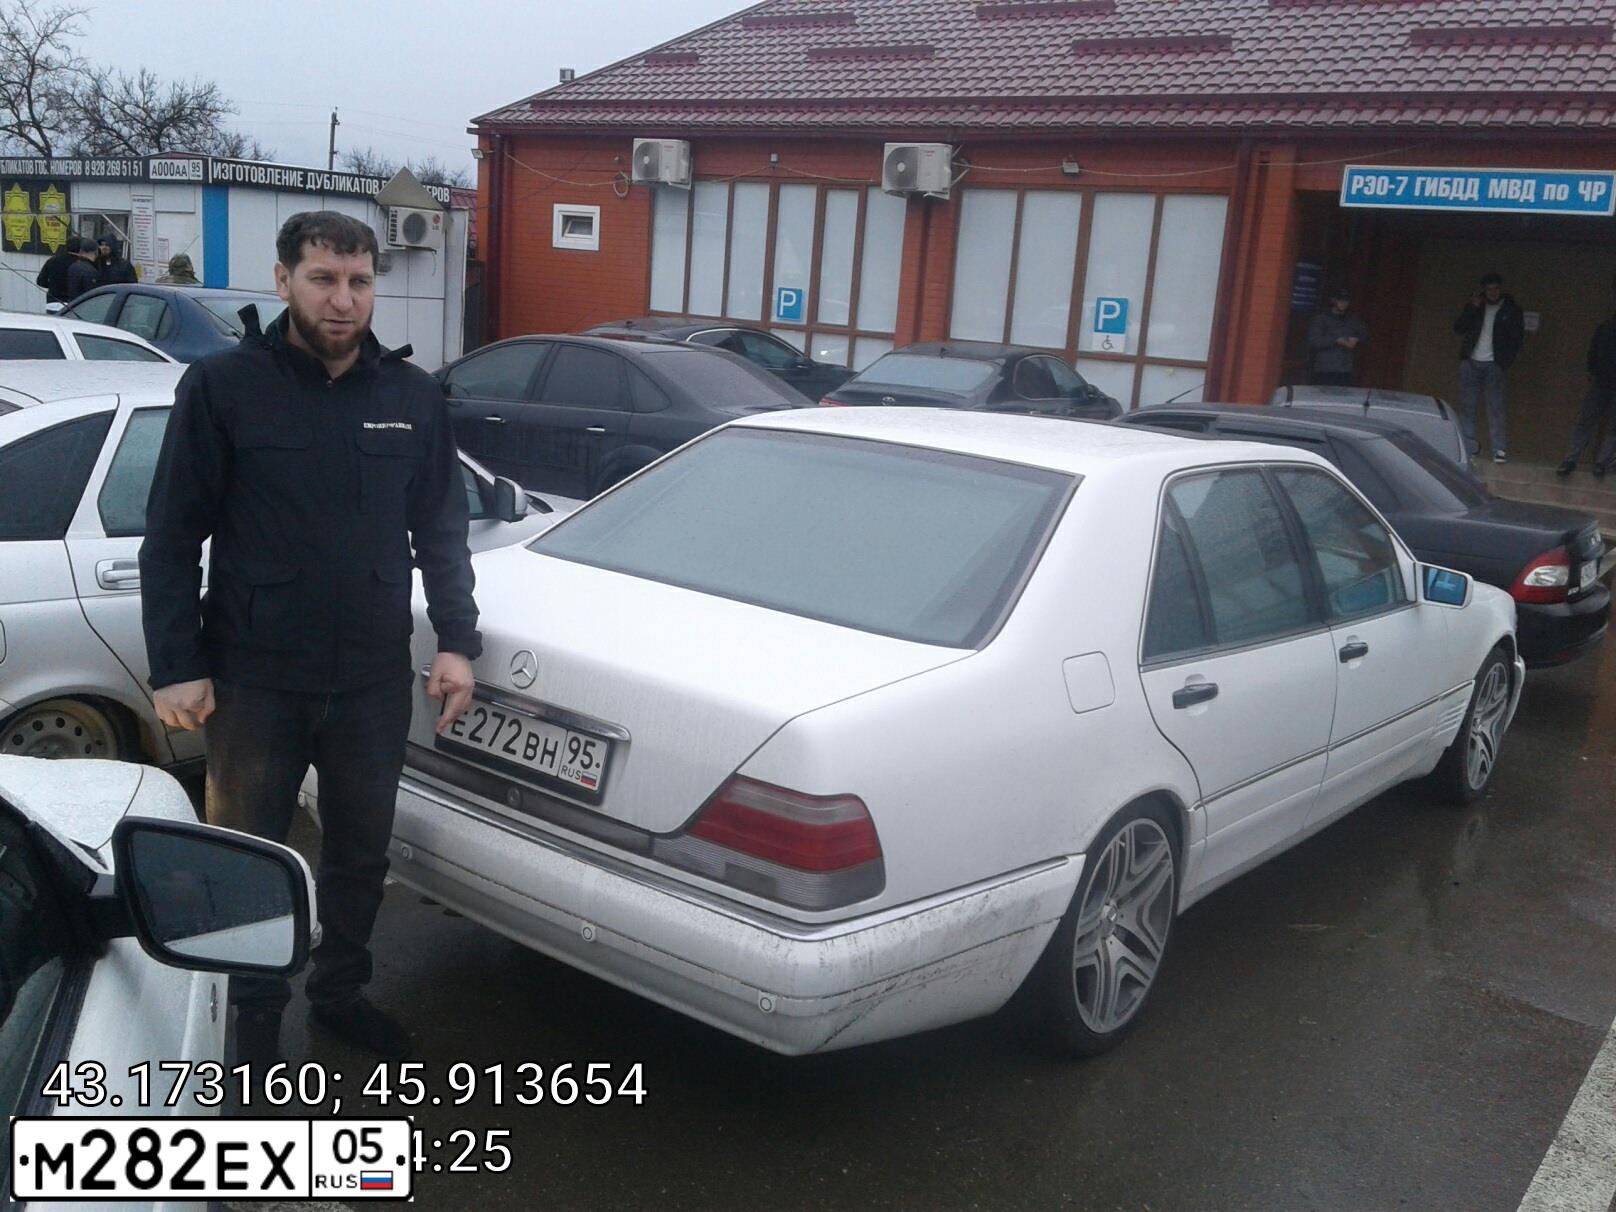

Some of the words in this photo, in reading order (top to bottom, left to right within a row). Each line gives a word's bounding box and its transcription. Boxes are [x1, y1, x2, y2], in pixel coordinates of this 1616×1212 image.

[51, 160, 82, 176] НОМЕРОВ
[85, 160, 90, 176] 8
[91, 160, 105, 176] 928
[106, 160, 120, 176] 269
[213, 161, 304, 188] ИЗГОТОВЛЕНИЕ
[306, 171, 380, 195] ДУБЛИКАТОВ
[1351, 175, 1409, 196] РЭО-7
[1414, 176, 1480, 201] ГИБДД
[1487, 178, 1537, 203] МВД
[1542, 183, 1570, 201] по
[1577, 180, 1607, 202] ЧР
[779, 290, 797, 317] P
[1099, 301, 1121, 331] P
[567, 735, 596, 770] 95
[560, 765, 582, 781] RUS
